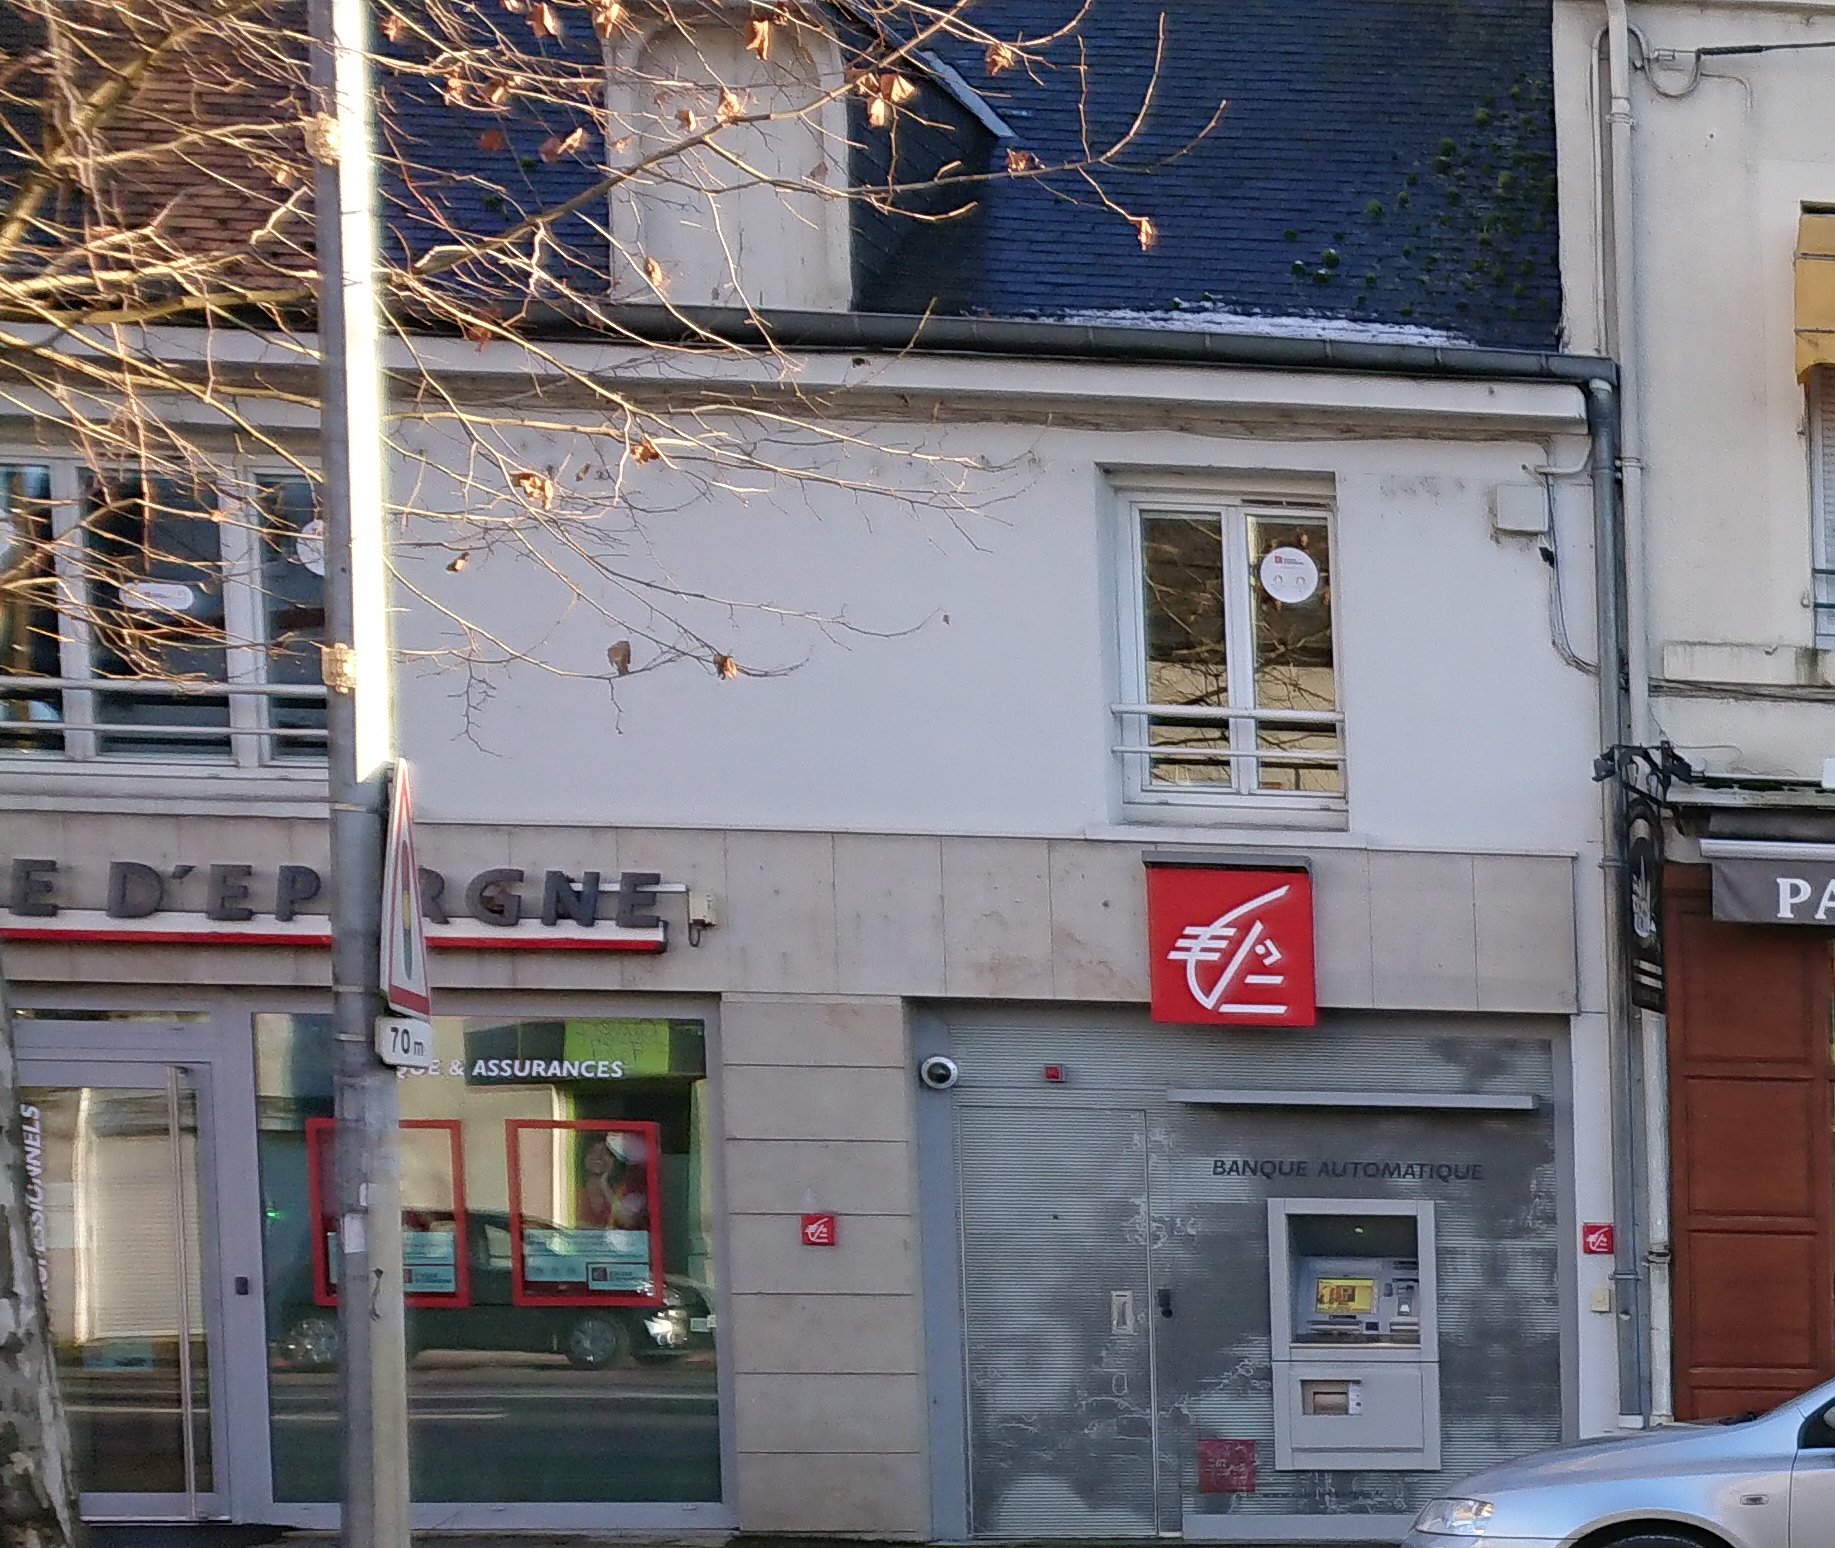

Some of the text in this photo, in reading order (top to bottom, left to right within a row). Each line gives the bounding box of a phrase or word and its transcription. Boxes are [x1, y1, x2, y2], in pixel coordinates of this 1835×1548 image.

[106, 860, 661, 928] D'EPRGNE
[472, 1059, 623, 1079] ASSURANCES
[1212, 1159, 1484, 1181] BANQUE AUTOMATIQUE
